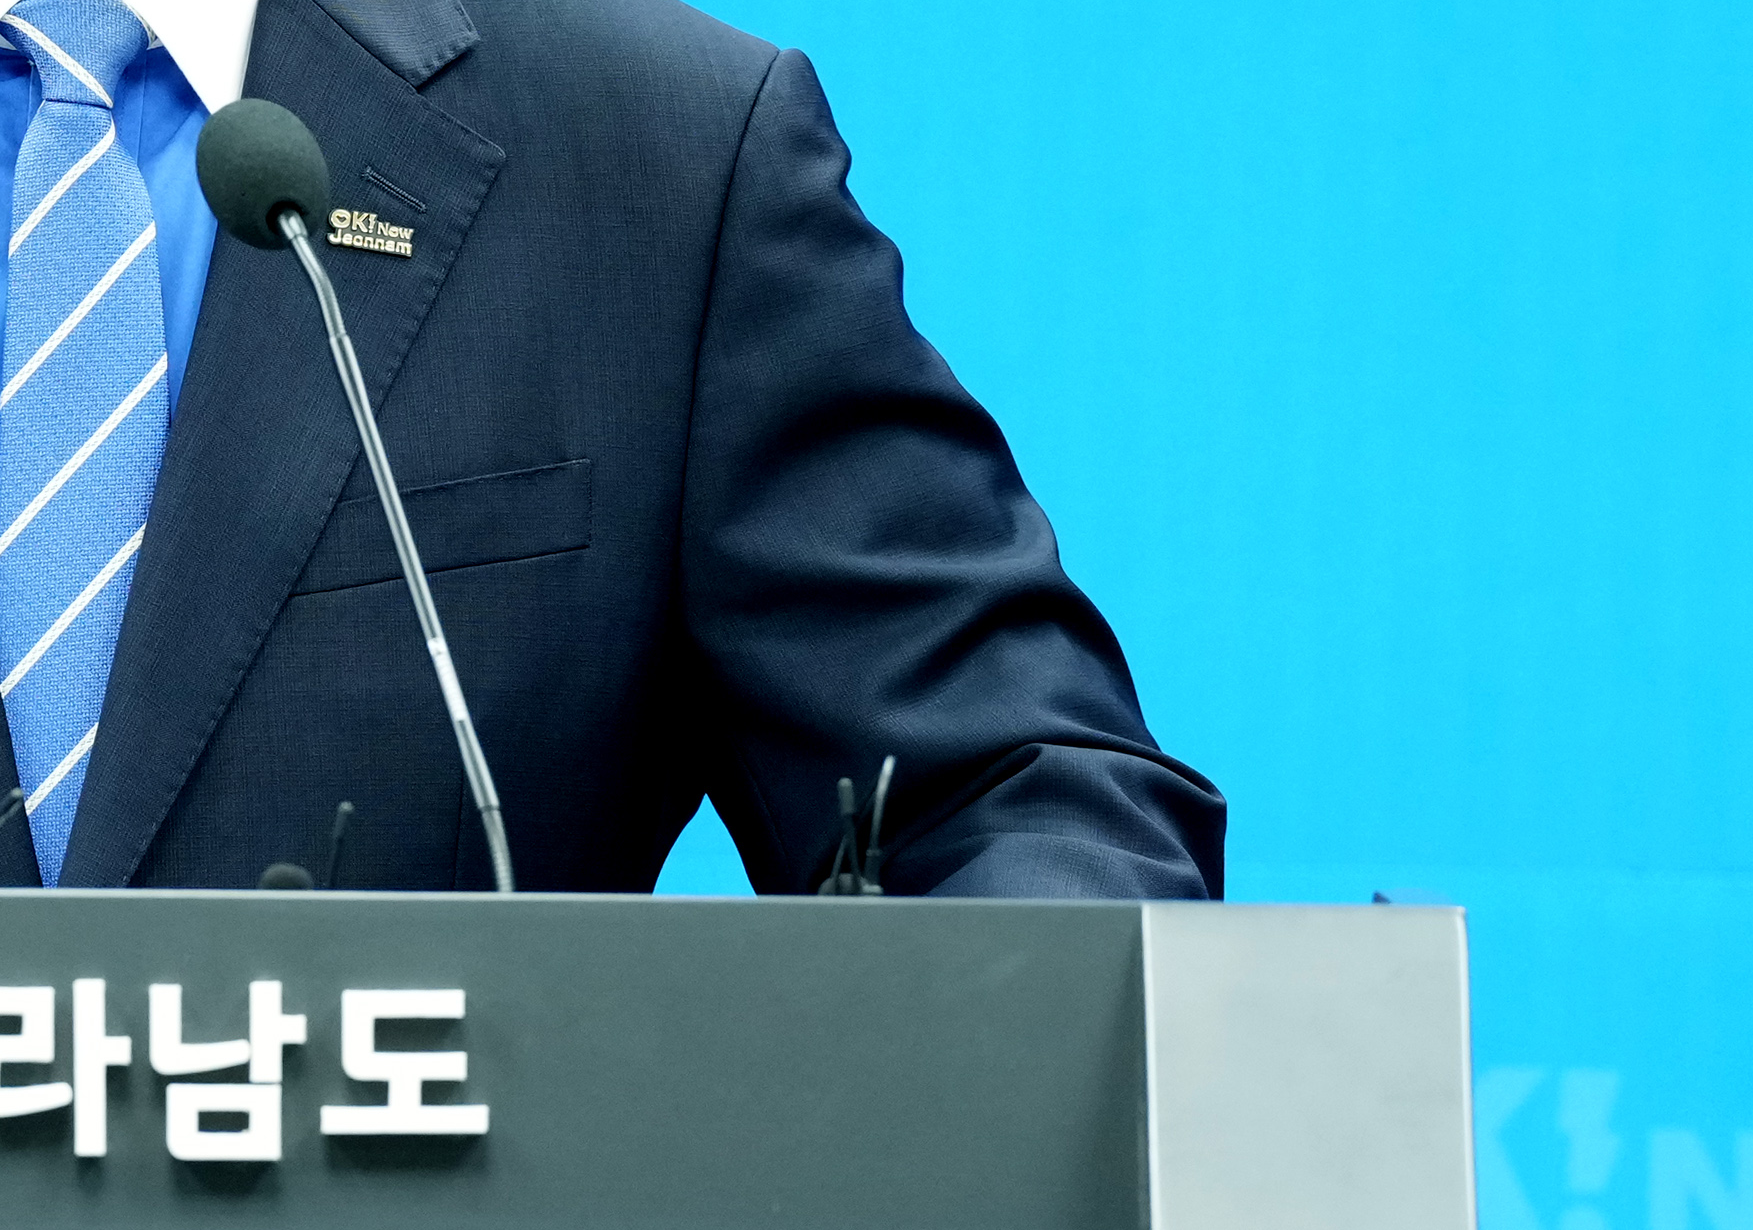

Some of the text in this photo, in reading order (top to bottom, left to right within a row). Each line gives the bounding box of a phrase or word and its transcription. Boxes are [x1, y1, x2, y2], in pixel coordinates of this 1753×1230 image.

[330, 208, 415, 240] OK! Now
[327, 227, 413, 256] Jeonnam
